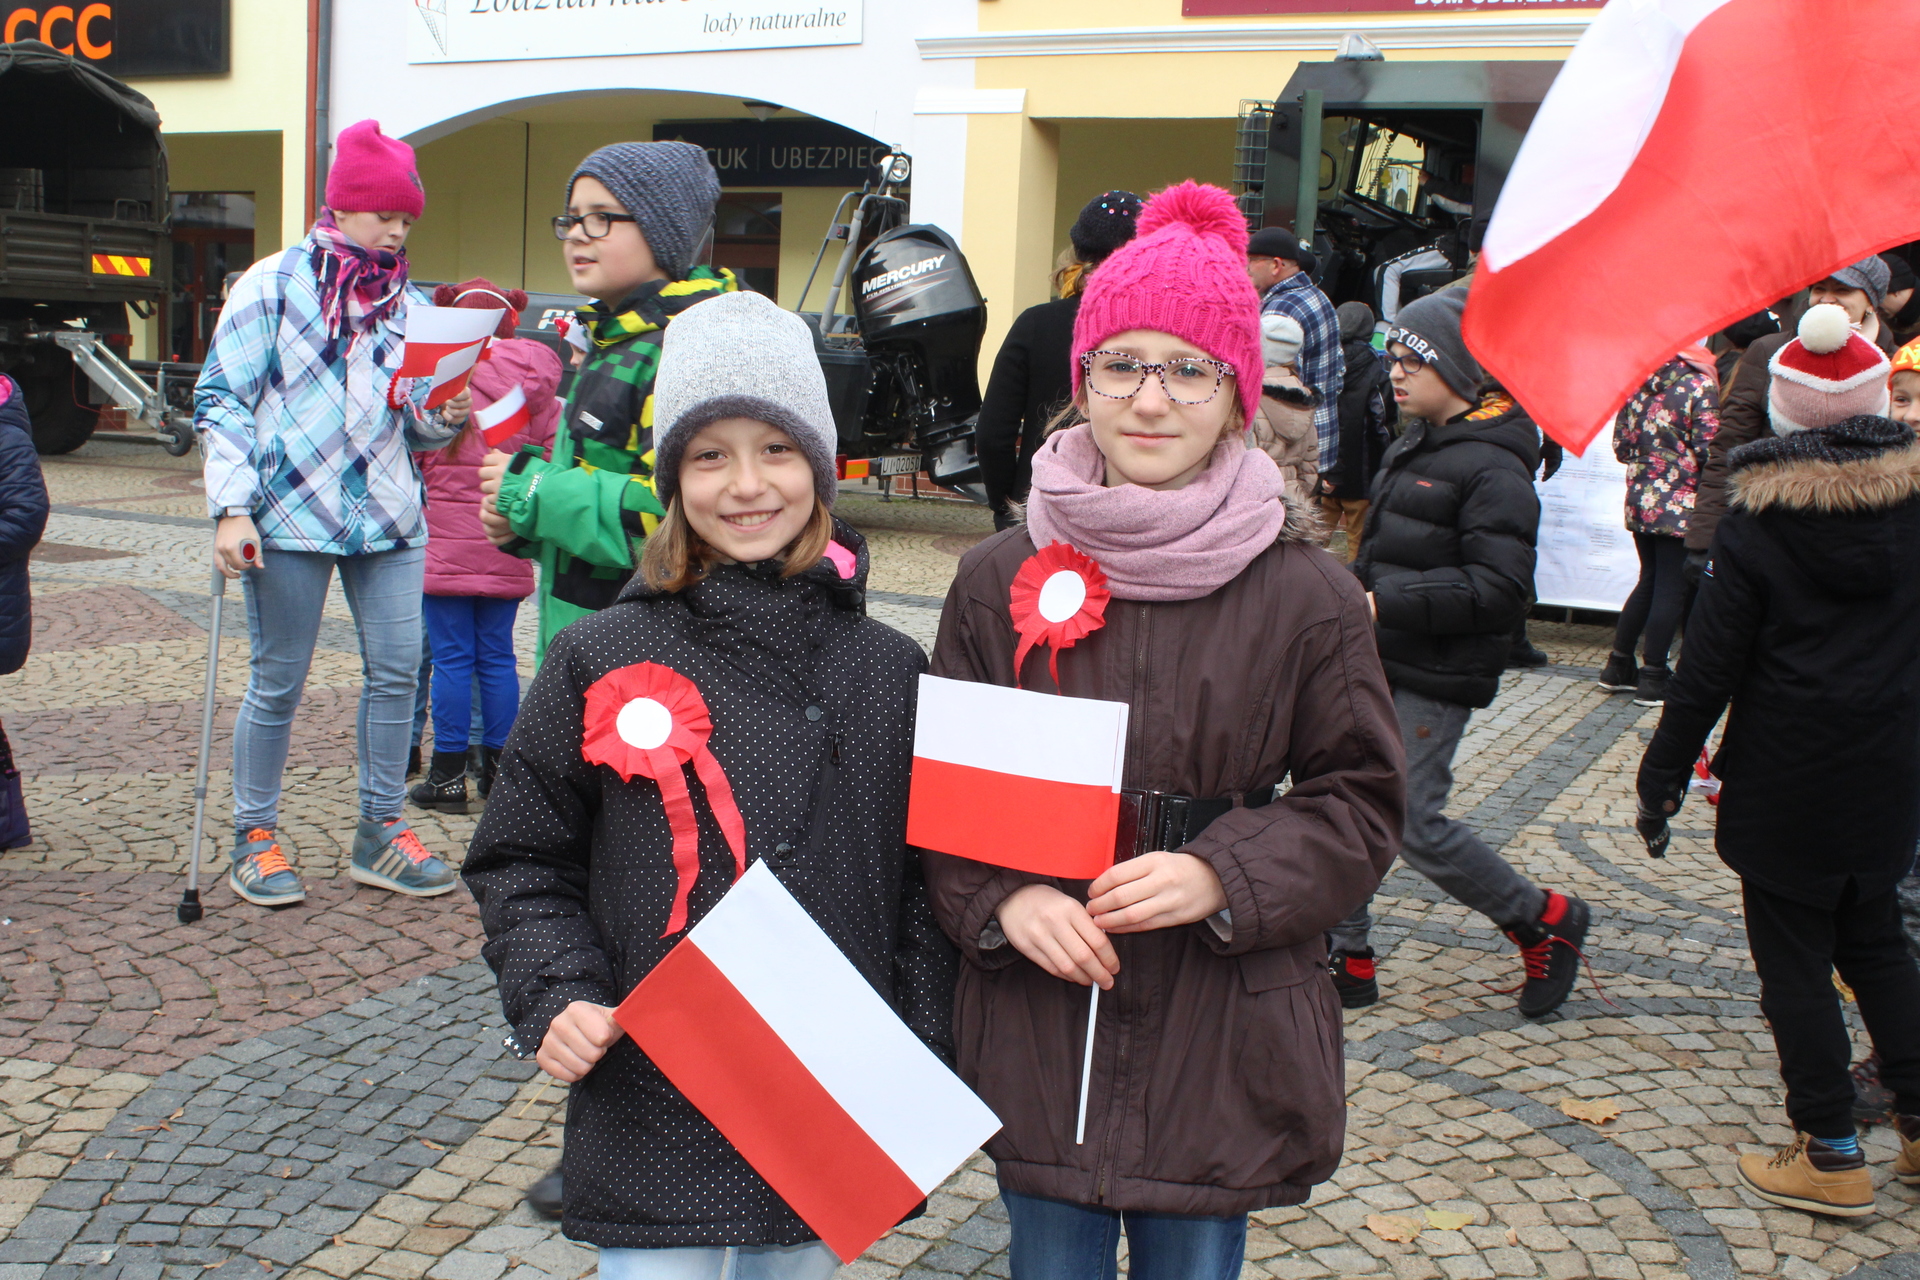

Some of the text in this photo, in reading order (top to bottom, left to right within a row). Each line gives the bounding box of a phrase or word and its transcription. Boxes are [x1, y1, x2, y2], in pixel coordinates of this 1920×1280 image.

[4, 2, 112, 60] CCC
[703, 7, 847, 36] lody naturalne
[862, 254, 946, 295] MERCURY
[1397, 327, 1439, 364] YORK
